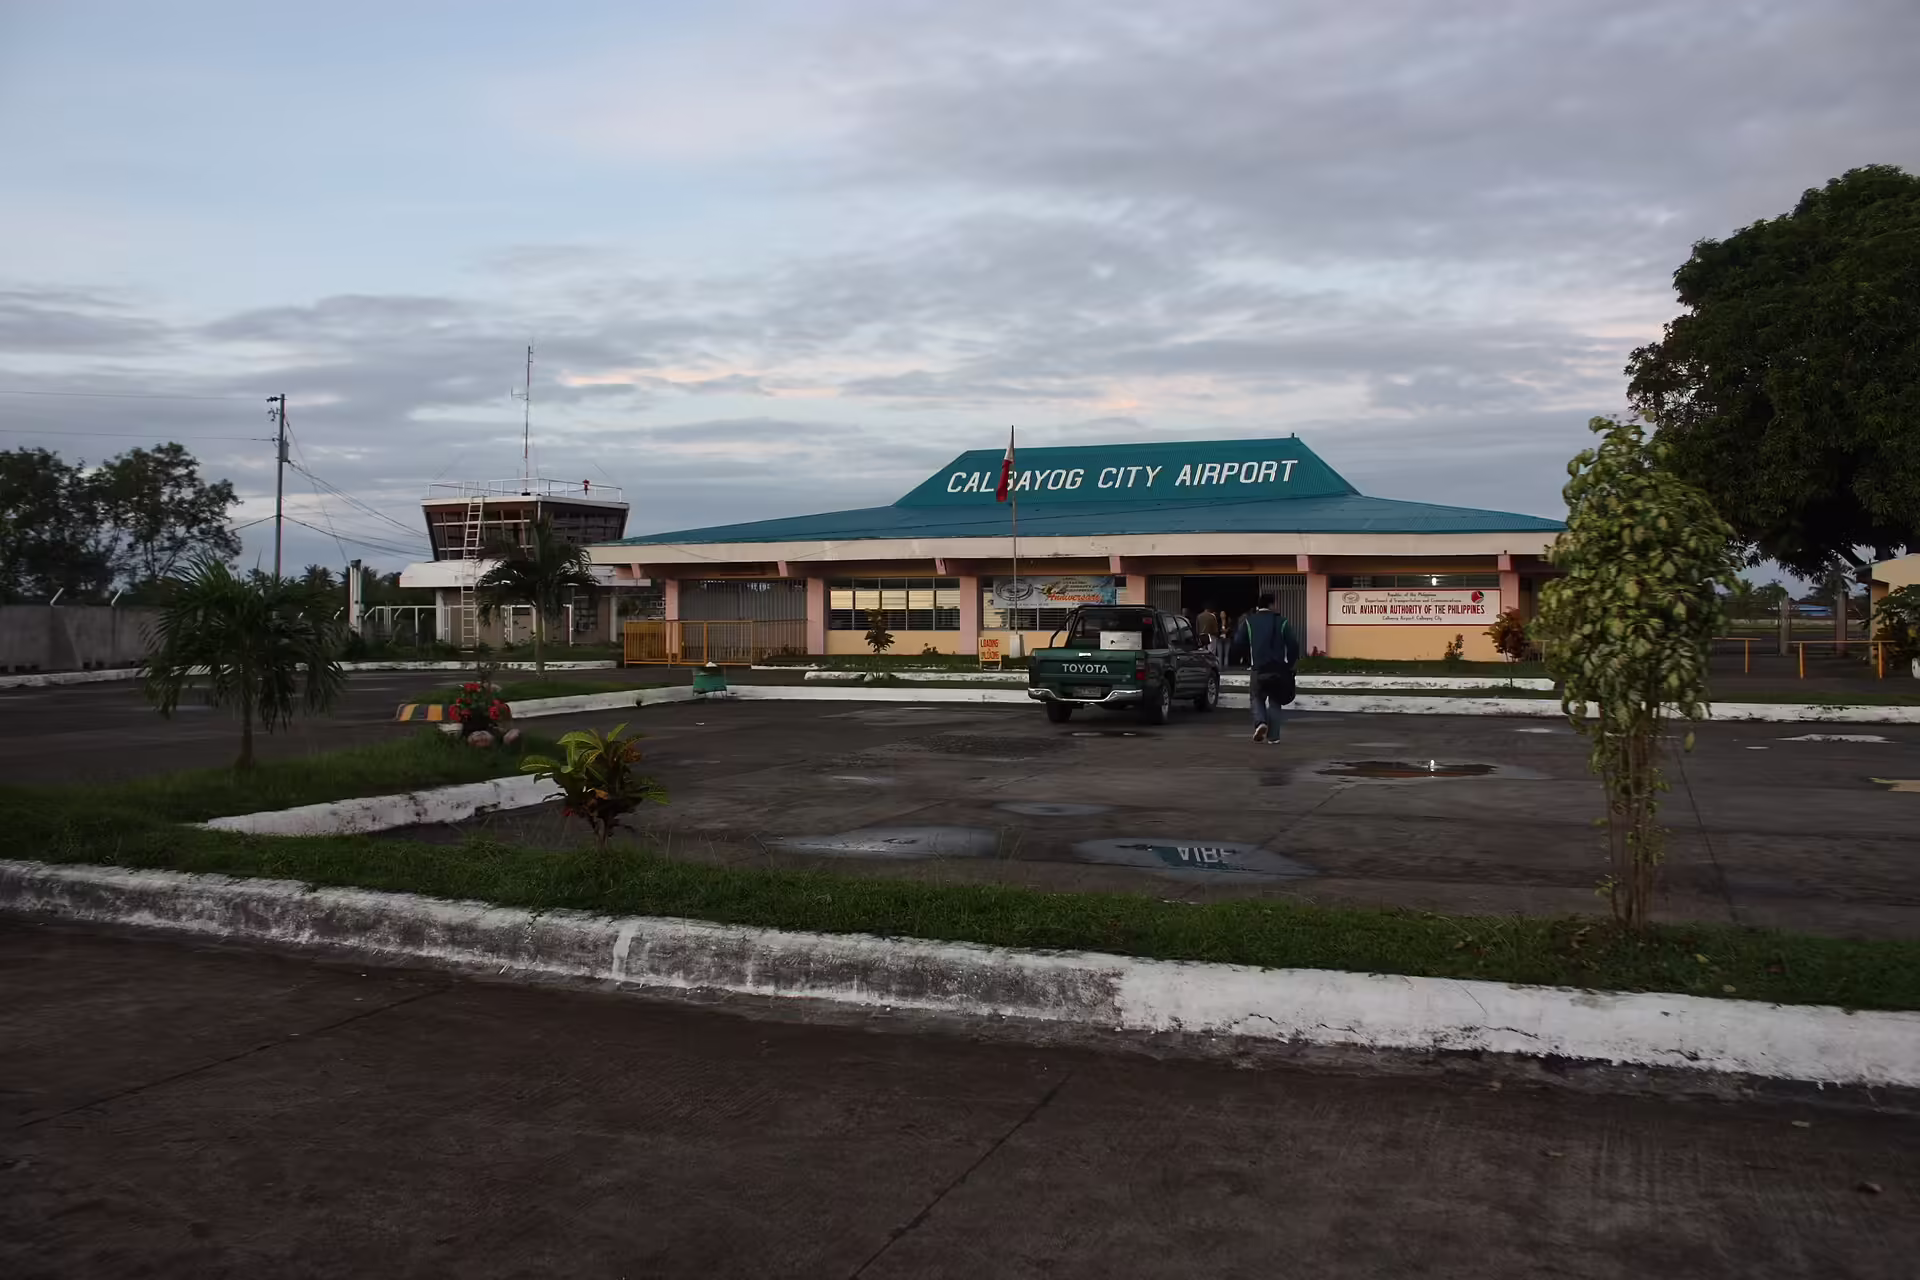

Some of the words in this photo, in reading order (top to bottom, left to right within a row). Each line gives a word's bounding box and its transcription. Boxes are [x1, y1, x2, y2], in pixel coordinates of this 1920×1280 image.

[1097, 465, 1163, 489] CITY
[1174, 459, 1299, 487] AIRPORT
[1341, 604, 1357, 615] CIVIL
[1360, 604, 1388, 615] AVIATION
[1389, 604, 1422, 615] AUTHORITY
[1424, 604, 1432, 615] OF
[1435, 604, 1446, 615] THE
[1447, 604, 1485, 615] PHILIPPINES
[980, 639, 999, 648] LOADING
[1062, 663, 1109, 674] TOYOTA
